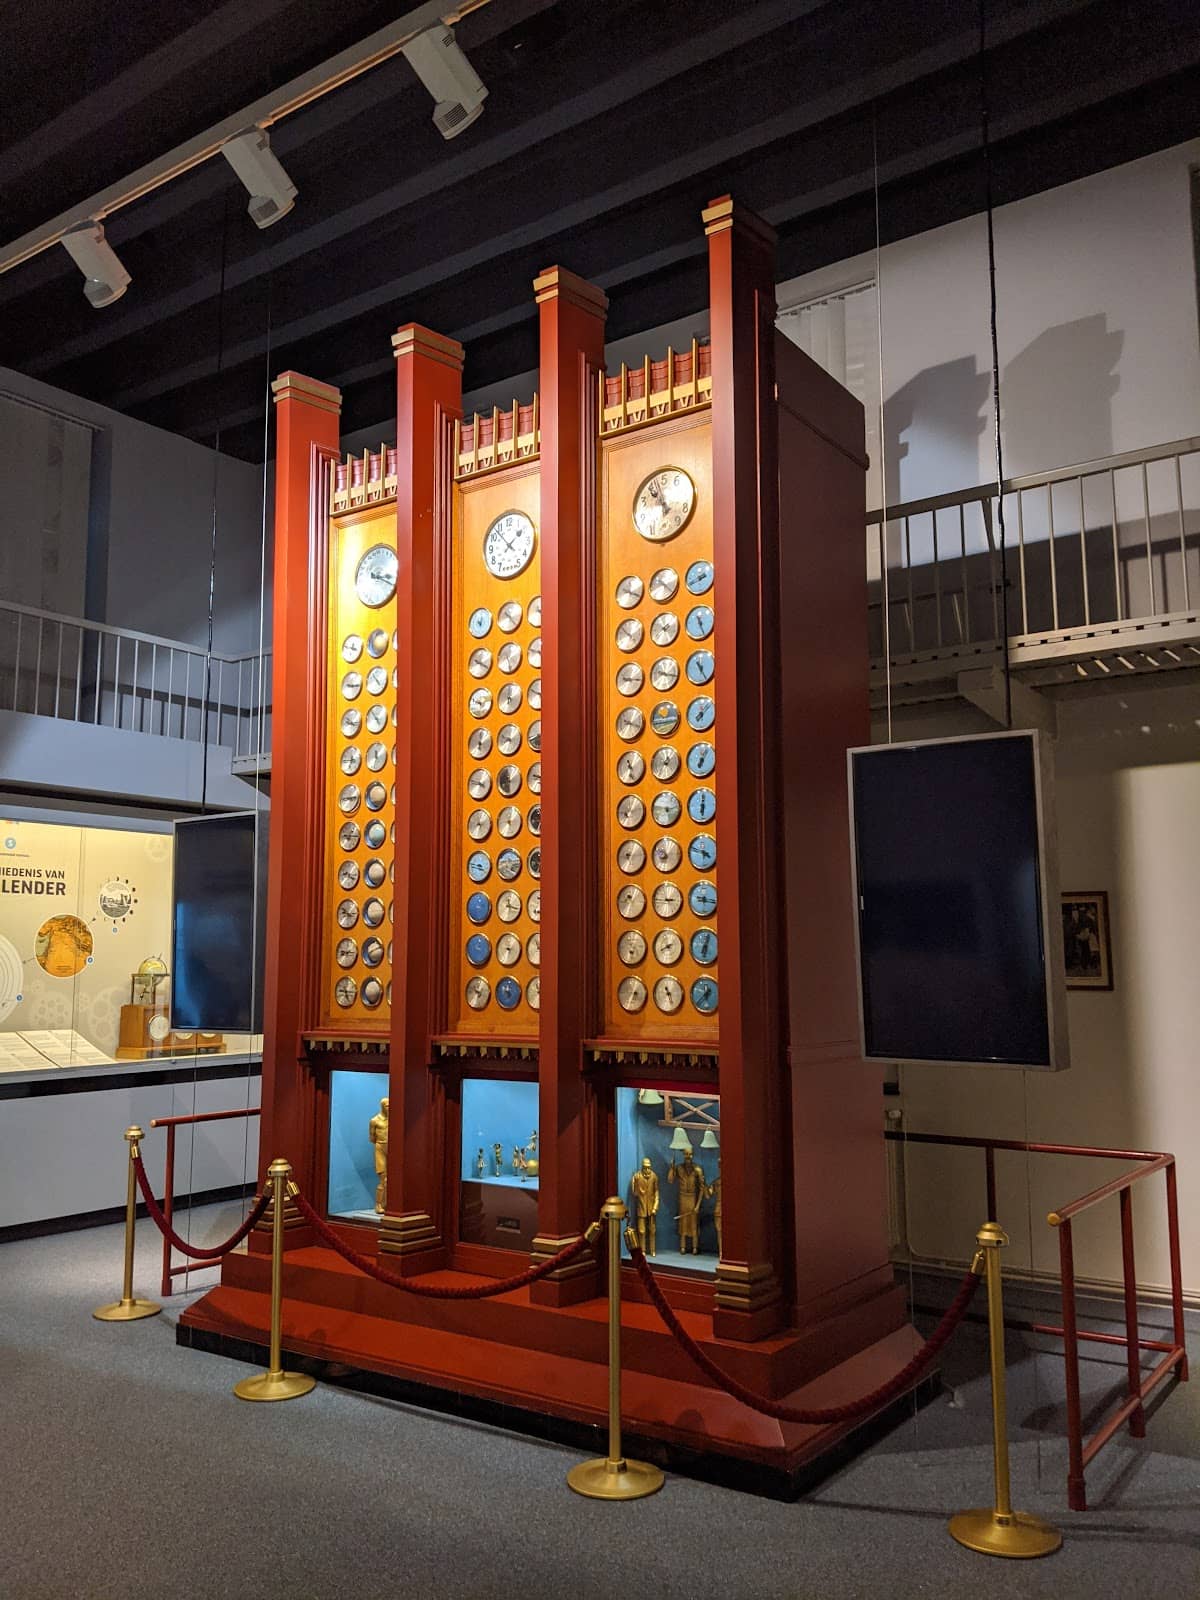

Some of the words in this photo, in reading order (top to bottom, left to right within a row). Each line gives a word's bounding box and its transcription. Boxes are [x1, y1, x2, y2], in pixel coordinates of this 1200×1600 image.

[660, 474, 668, 486] 5
[674, 476, 680, 486] 6
[682, 502, 688, 514] 8
[498, 522, 502, 532] 11
[506, 518, 512, 528] 12
[491, 532, 498, 542] 10
[488, 545, 494, 554] 9
[522, 549, 527, 558] 4
[491, 556, 496, 565] 8
[498, 562, 502, 572] 7
[45, 870, 64, 879] VAN
[2, 880, 66, 896] LENDER
